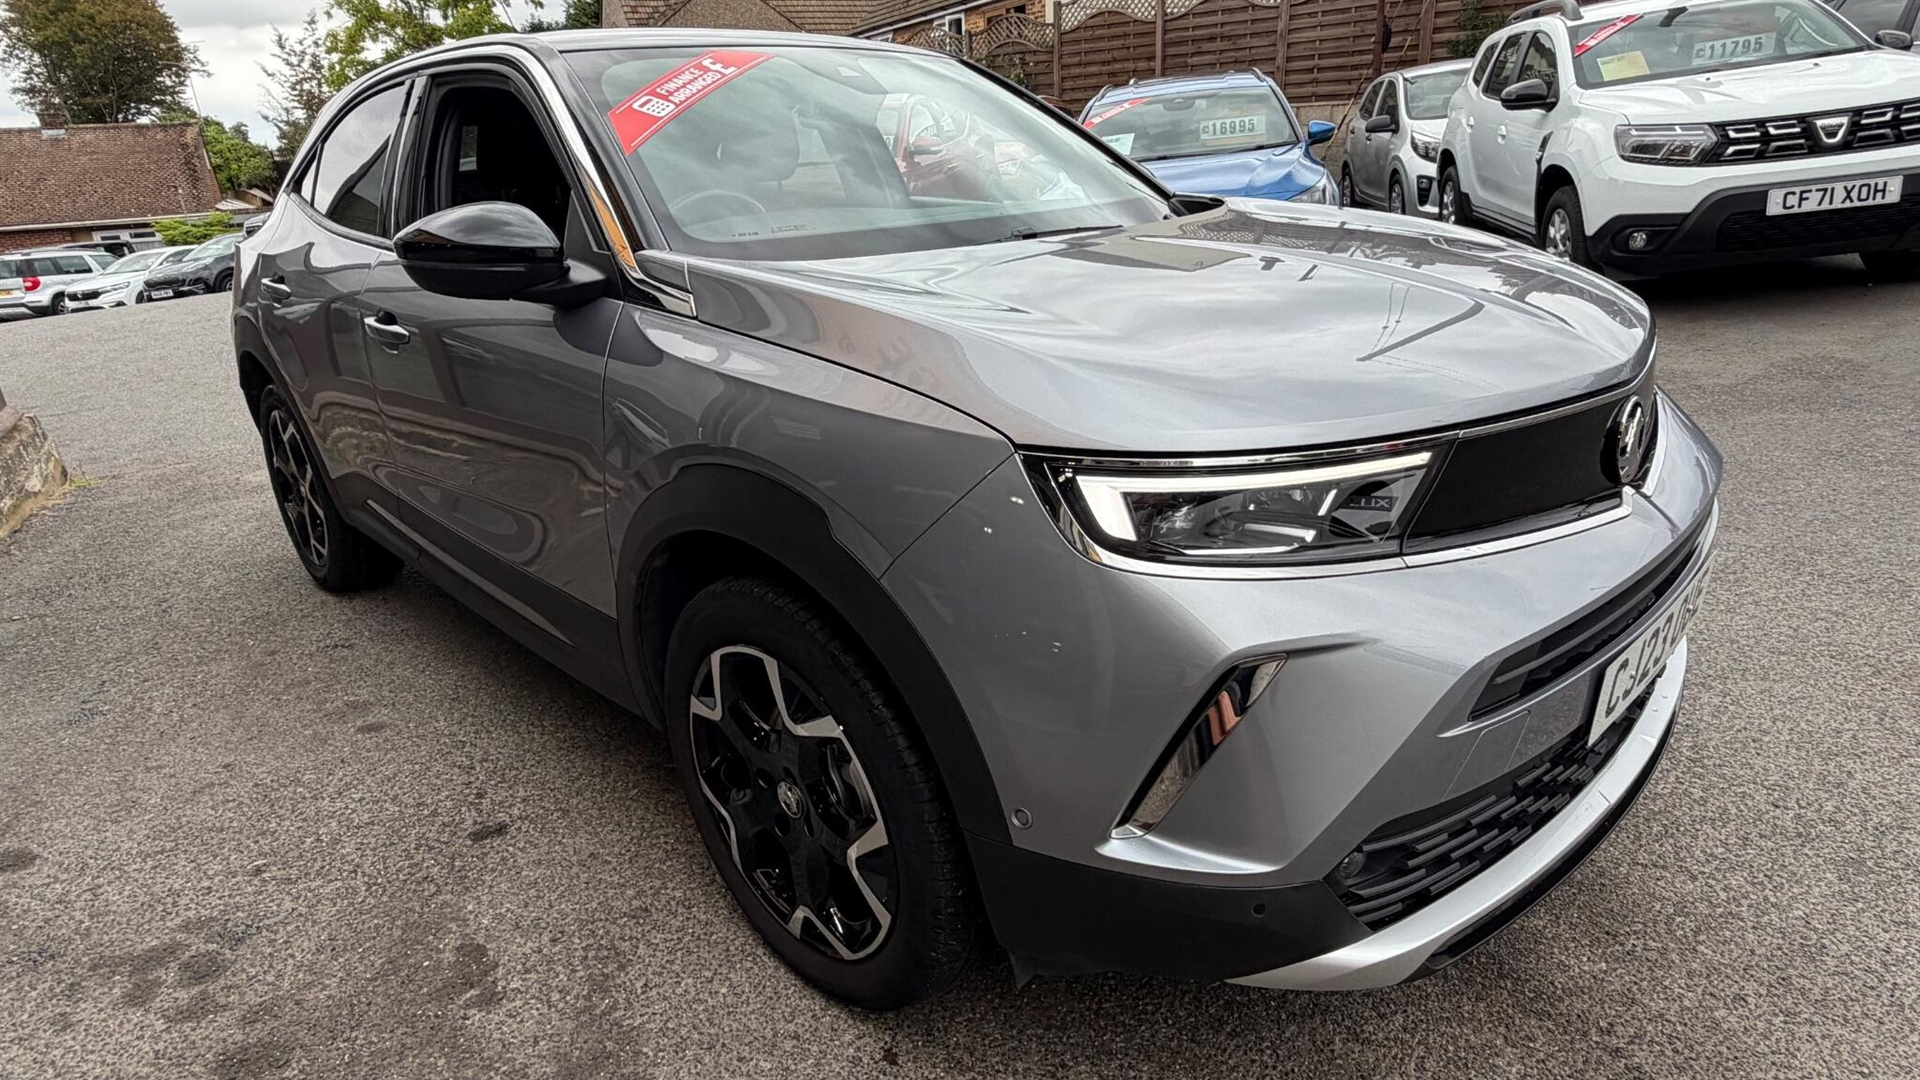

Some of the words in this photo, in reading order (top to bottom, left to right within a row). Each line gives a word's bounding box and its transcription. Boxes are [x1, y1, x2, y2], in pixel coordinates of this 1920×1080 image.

[1694, 36, 1764, 59] £11795
[655, 67, 705, 96] FINANCE
[668, 71, 722, 104] ARRANGED
[1201, 118, 1256, 136] £16995
[1781, 186, 1836, 210] CF71
[1840, 181, 1888, 204] XOH
[1604, 611, 1675, 719] CJ23
